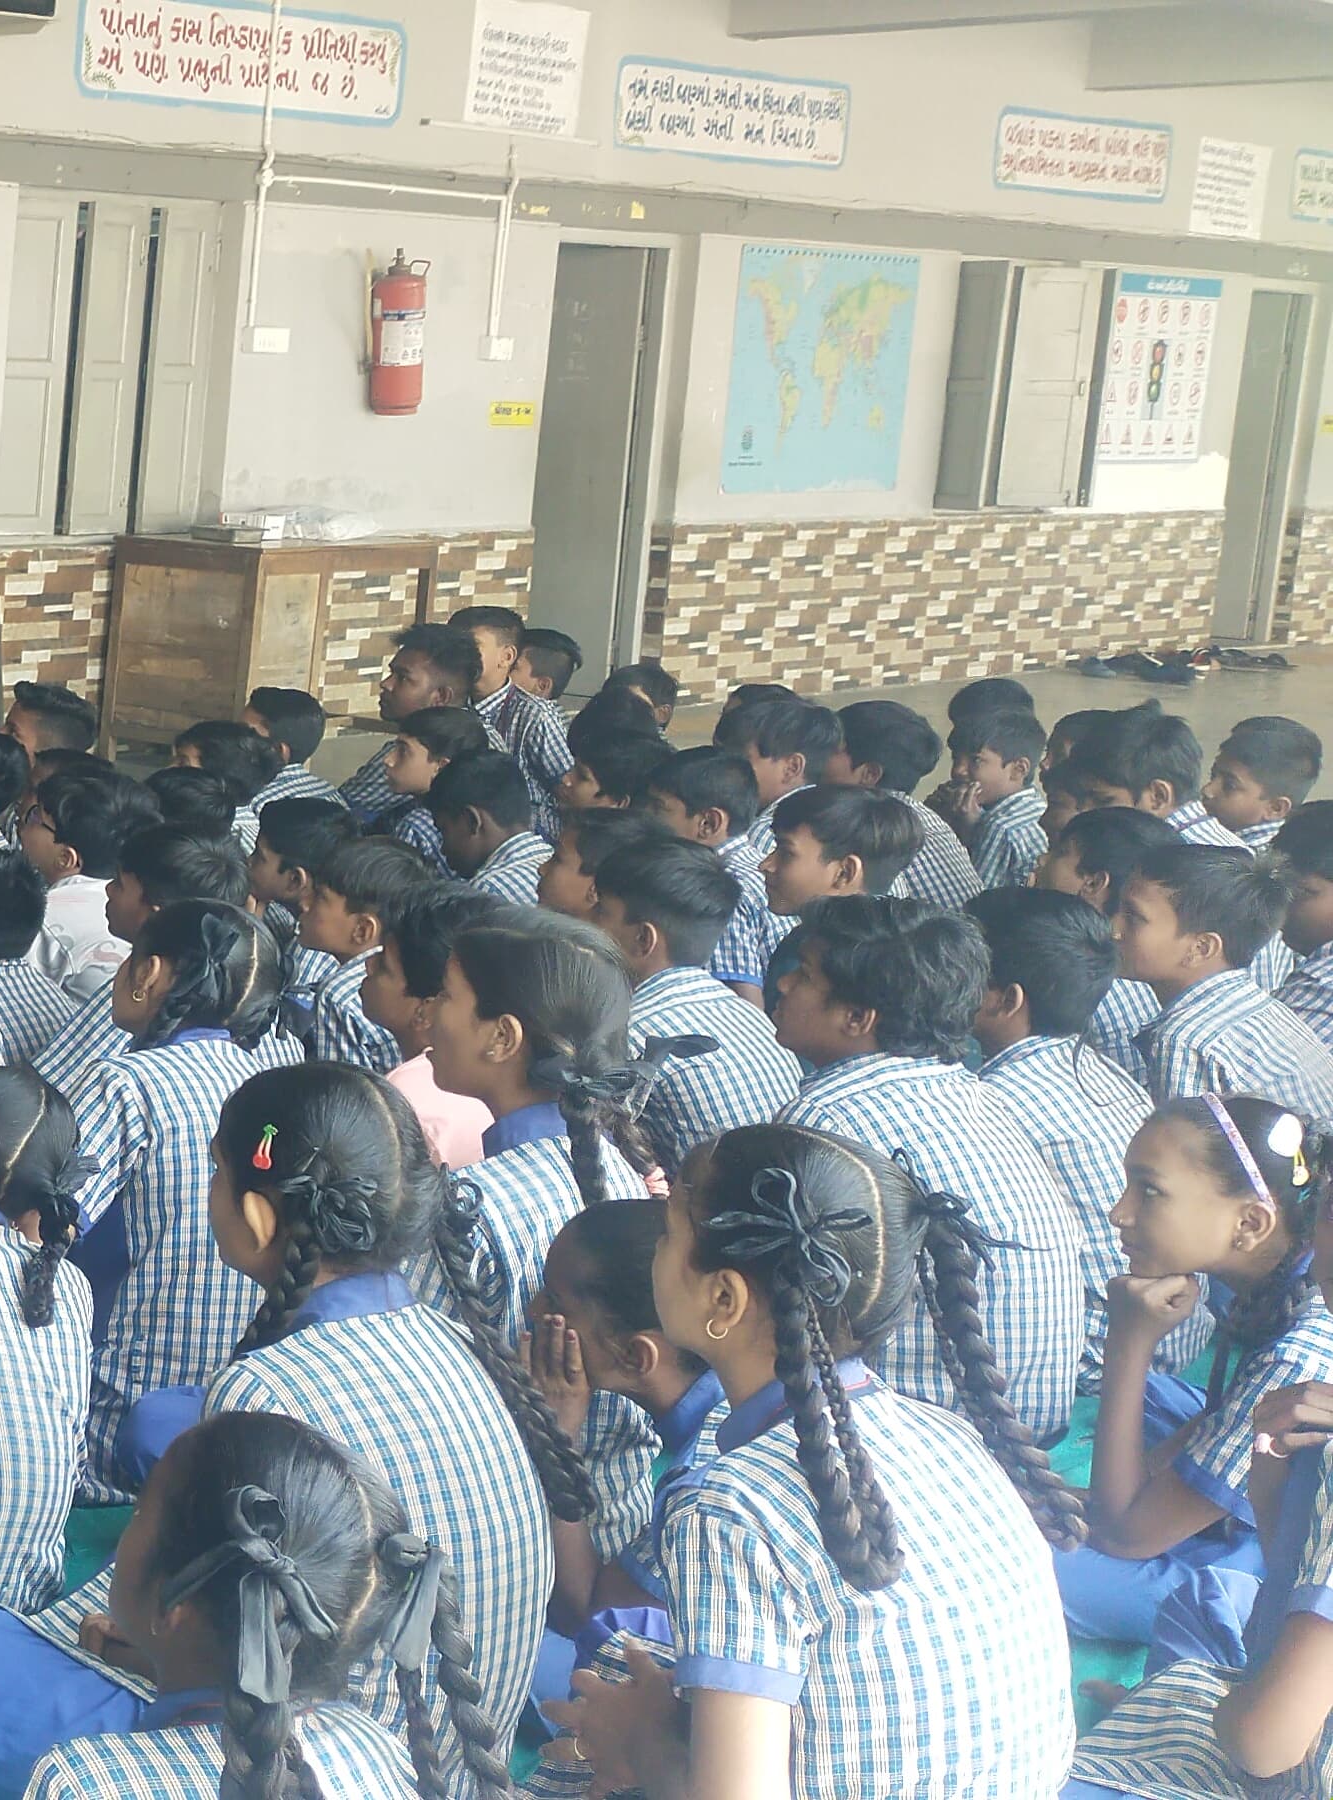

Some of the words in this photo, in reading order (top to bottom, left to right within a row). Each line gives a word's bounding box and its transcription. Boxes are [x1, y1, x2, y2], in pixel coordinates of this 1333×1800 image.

[99, 0, 162, 49] પોતાનું
[170, 16, 203, 44] કામ
[133, 50, 168, 83] પણ
[178, 53, 232, 93] પ્રભુની
[311, 71, 330, 96] જ
